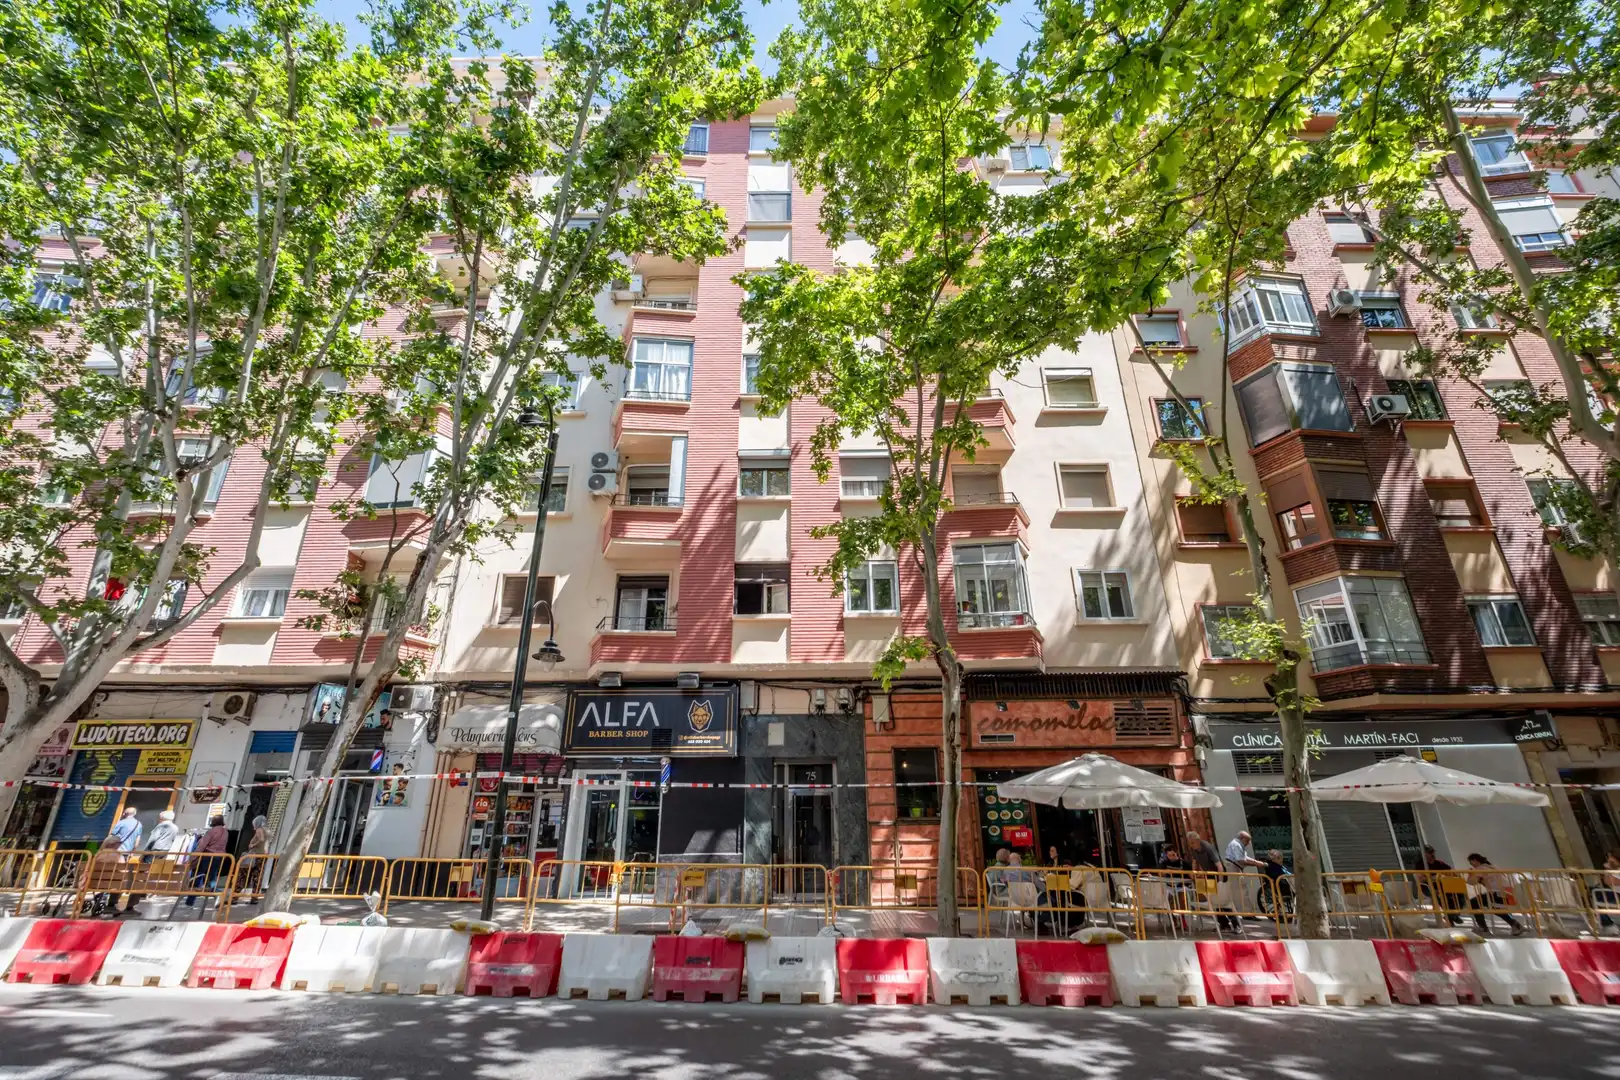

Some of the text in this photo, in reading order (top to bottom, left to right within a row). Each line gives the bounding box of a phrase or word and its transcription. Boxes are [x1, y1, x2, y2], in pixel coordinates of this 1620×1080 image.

[577, 701, 661, 727] ALFA
[77, 724, 189, 743] LUDOTECO.ORG
[588, 729, 649, 738] BARBER SHOP
[1534, 731, 1553, 739] DENTAL
[1232, 732, 1283, 747] CLÍNICA
[1343, 731, 1420, 745] MARTÍN-FACI
[805, 771, 817, 781] 75
[475, 798, 489, 807] ria
